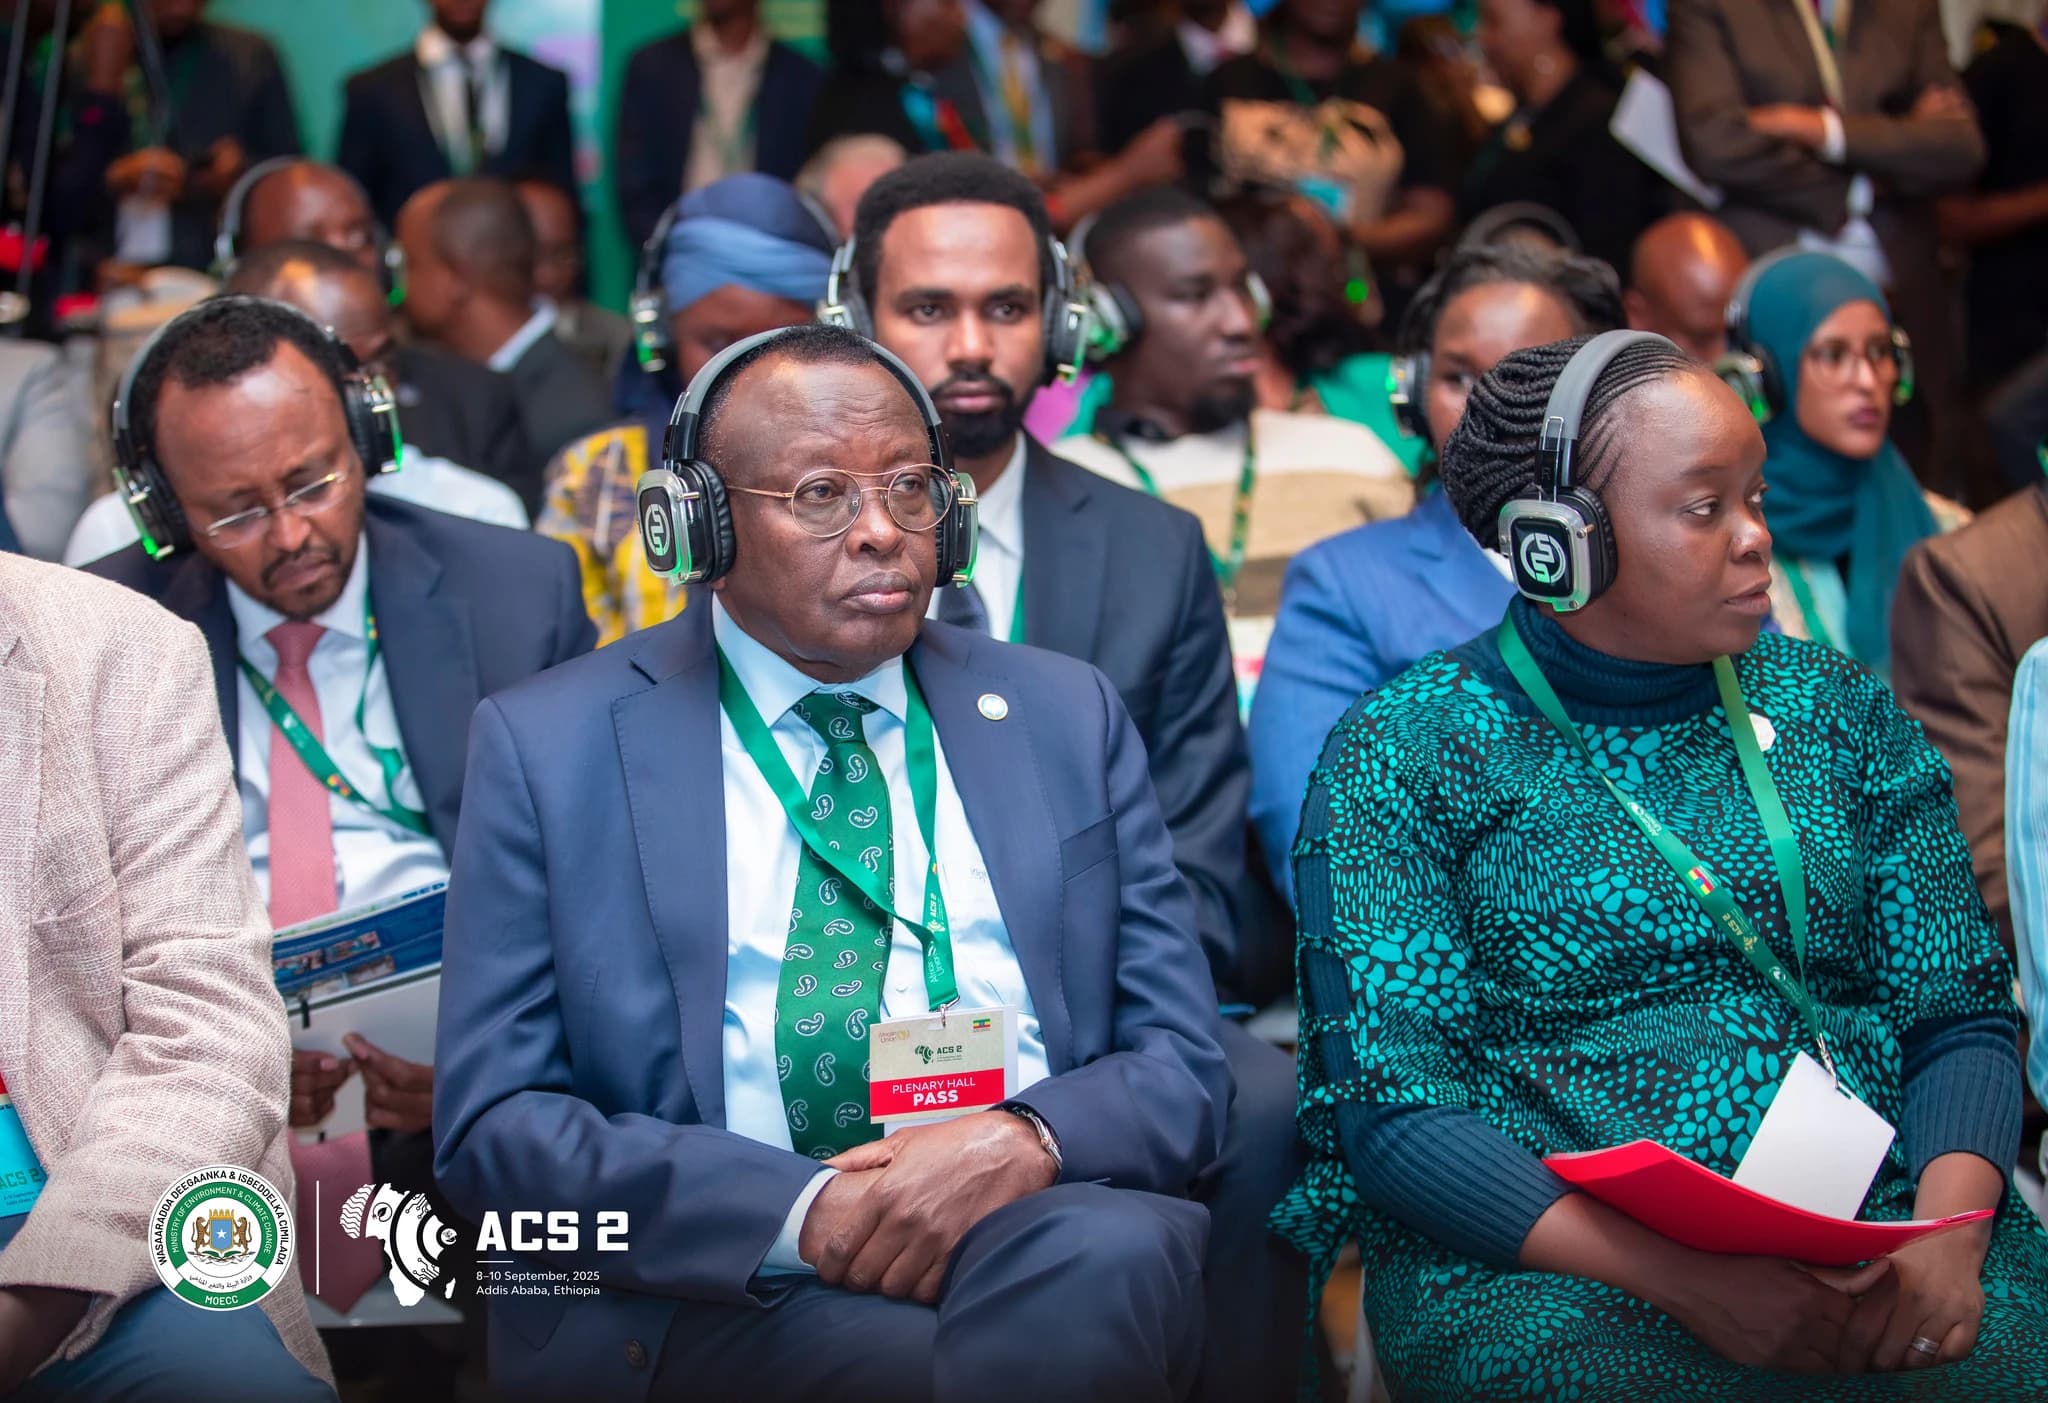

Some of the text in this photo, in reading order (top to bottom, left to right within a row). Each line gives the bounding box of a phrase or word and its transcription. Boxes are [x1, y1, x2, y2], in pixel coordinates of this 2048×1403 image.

[1722, 912, 1731, 921] 2
[1728, 919, 1743, 936] ACS
[937, 1045, 963, 1055] ACS 2
[892, 1076, 976, 1095] PLENARY HALL
[913, 1090, 959, 1106] PASS
[29, 1168, 41, 1182] 2
